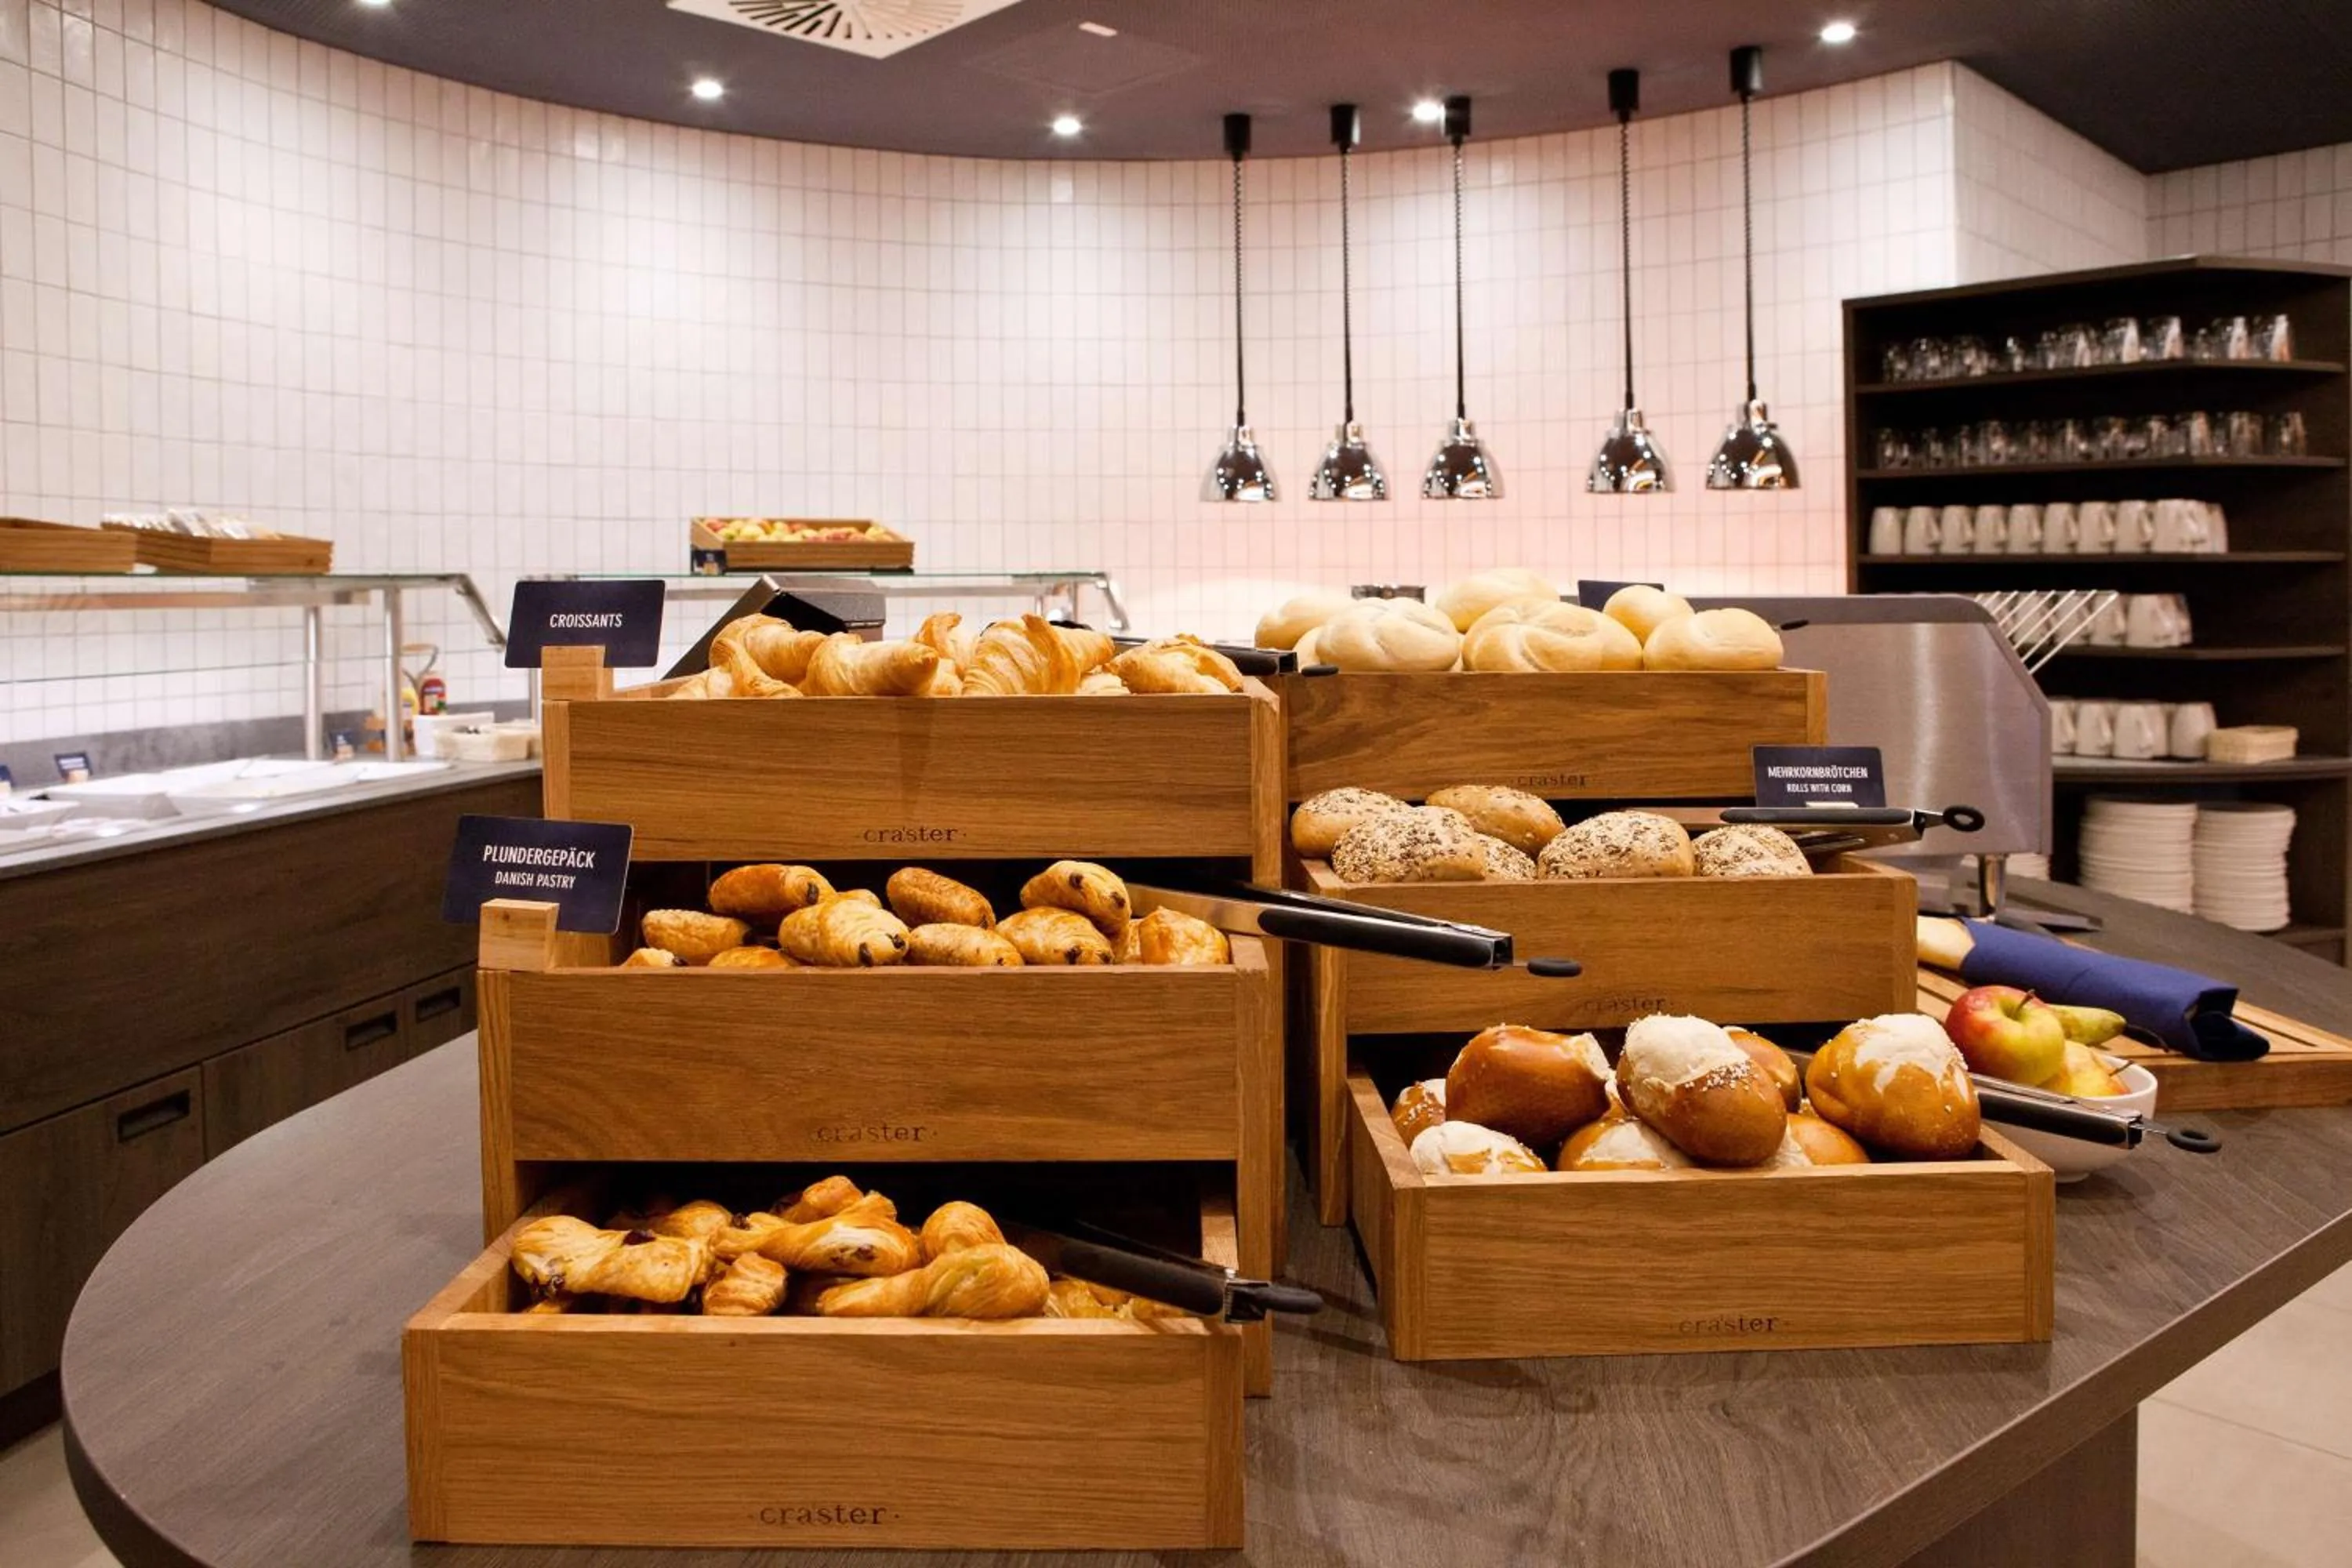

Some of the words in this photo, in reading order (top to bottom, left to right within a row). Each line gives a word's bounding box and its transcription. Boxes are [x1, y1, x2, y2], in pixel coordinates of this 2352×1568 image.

[550, 614, 622, 628] CROISSANTS
[1767, 764, 1868, 779] MEHRKORNBRÖTCHEN
[1810, 784, 1830, 793] WITH
[863, 826, 958, 843] craster
[483, 844, 596, 869] PLUNDERGEPÄCK
[495, 871, 534, 887] DANISH
[535, 873, 576, 890] PASTRY
[817, 1120, 927, 1142] craster
[759, 1504, 887, 1526] craster
